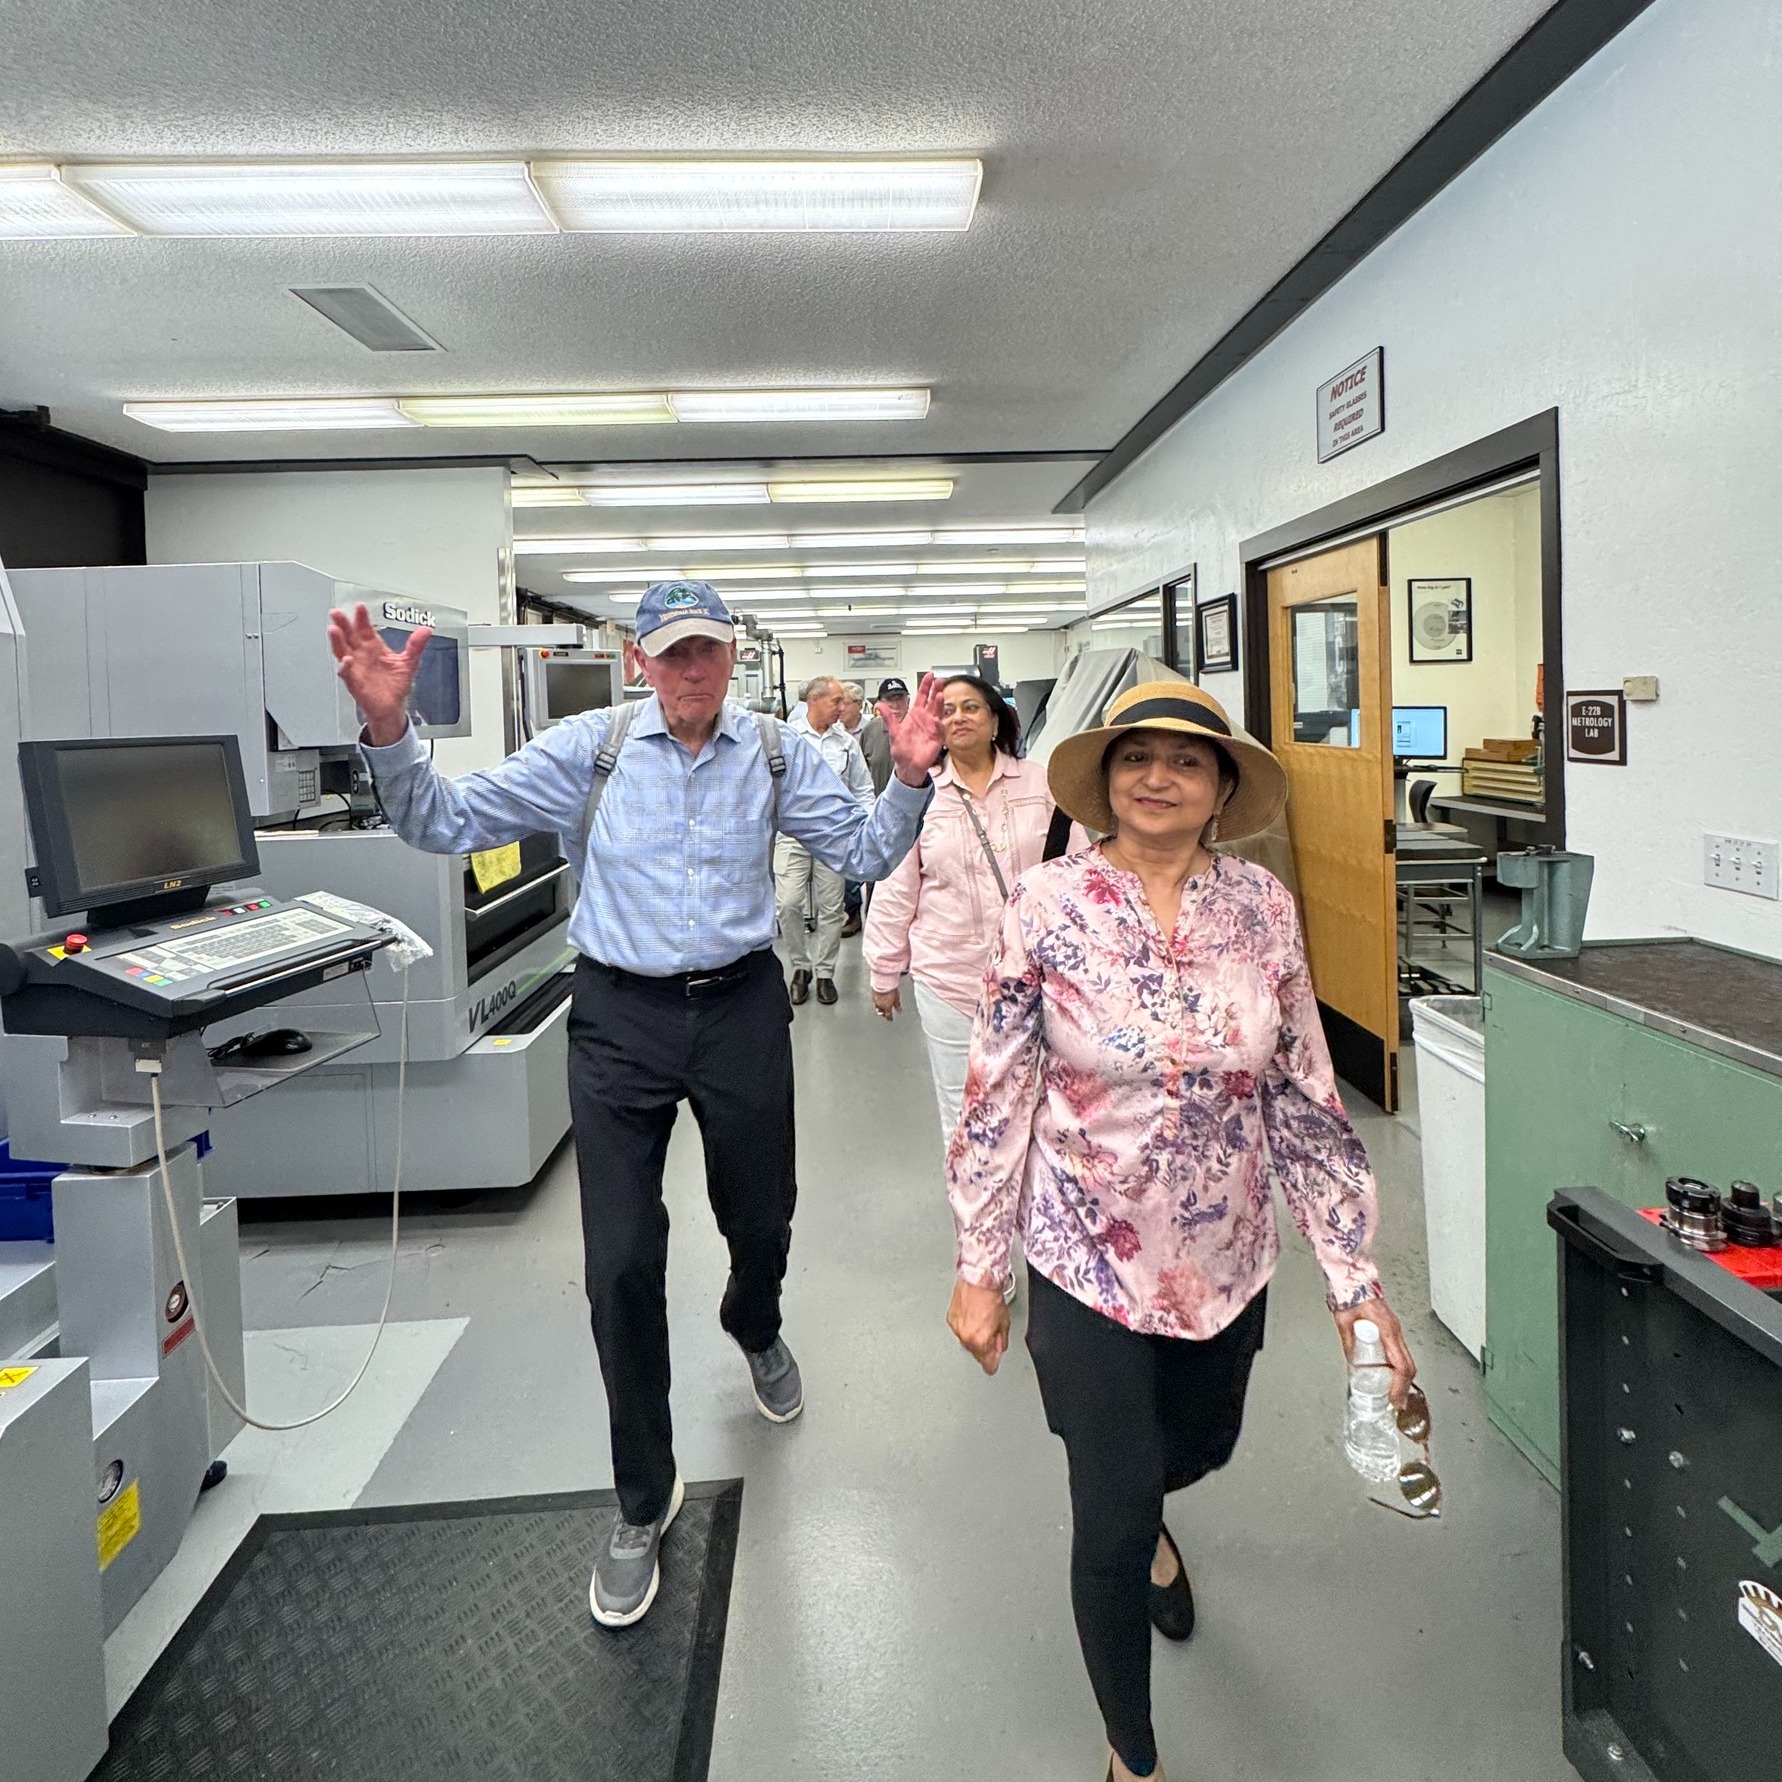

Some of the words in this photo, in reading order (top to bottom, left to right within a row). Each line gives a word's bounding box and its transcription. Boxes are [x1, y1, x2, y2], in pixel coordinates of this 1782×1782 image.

[1330, 365, 1367, 402] NOTICE
[1328, 404, 1345, 420] SAFETY
[1346, 390, 1367, 409] GLASSES
[1333, 408, 1364, 432] REQUIRED
[383, 601, 436, 628] Sodick
[1572, 717, 1613, 727] METROLOGY
[1582, 706, 1601, 716] E-22B
[1585, 728, 1599, 738] LAB
[163, 880, 182, 889] LN2
[469, 980, 516, 1034] VL400Q
